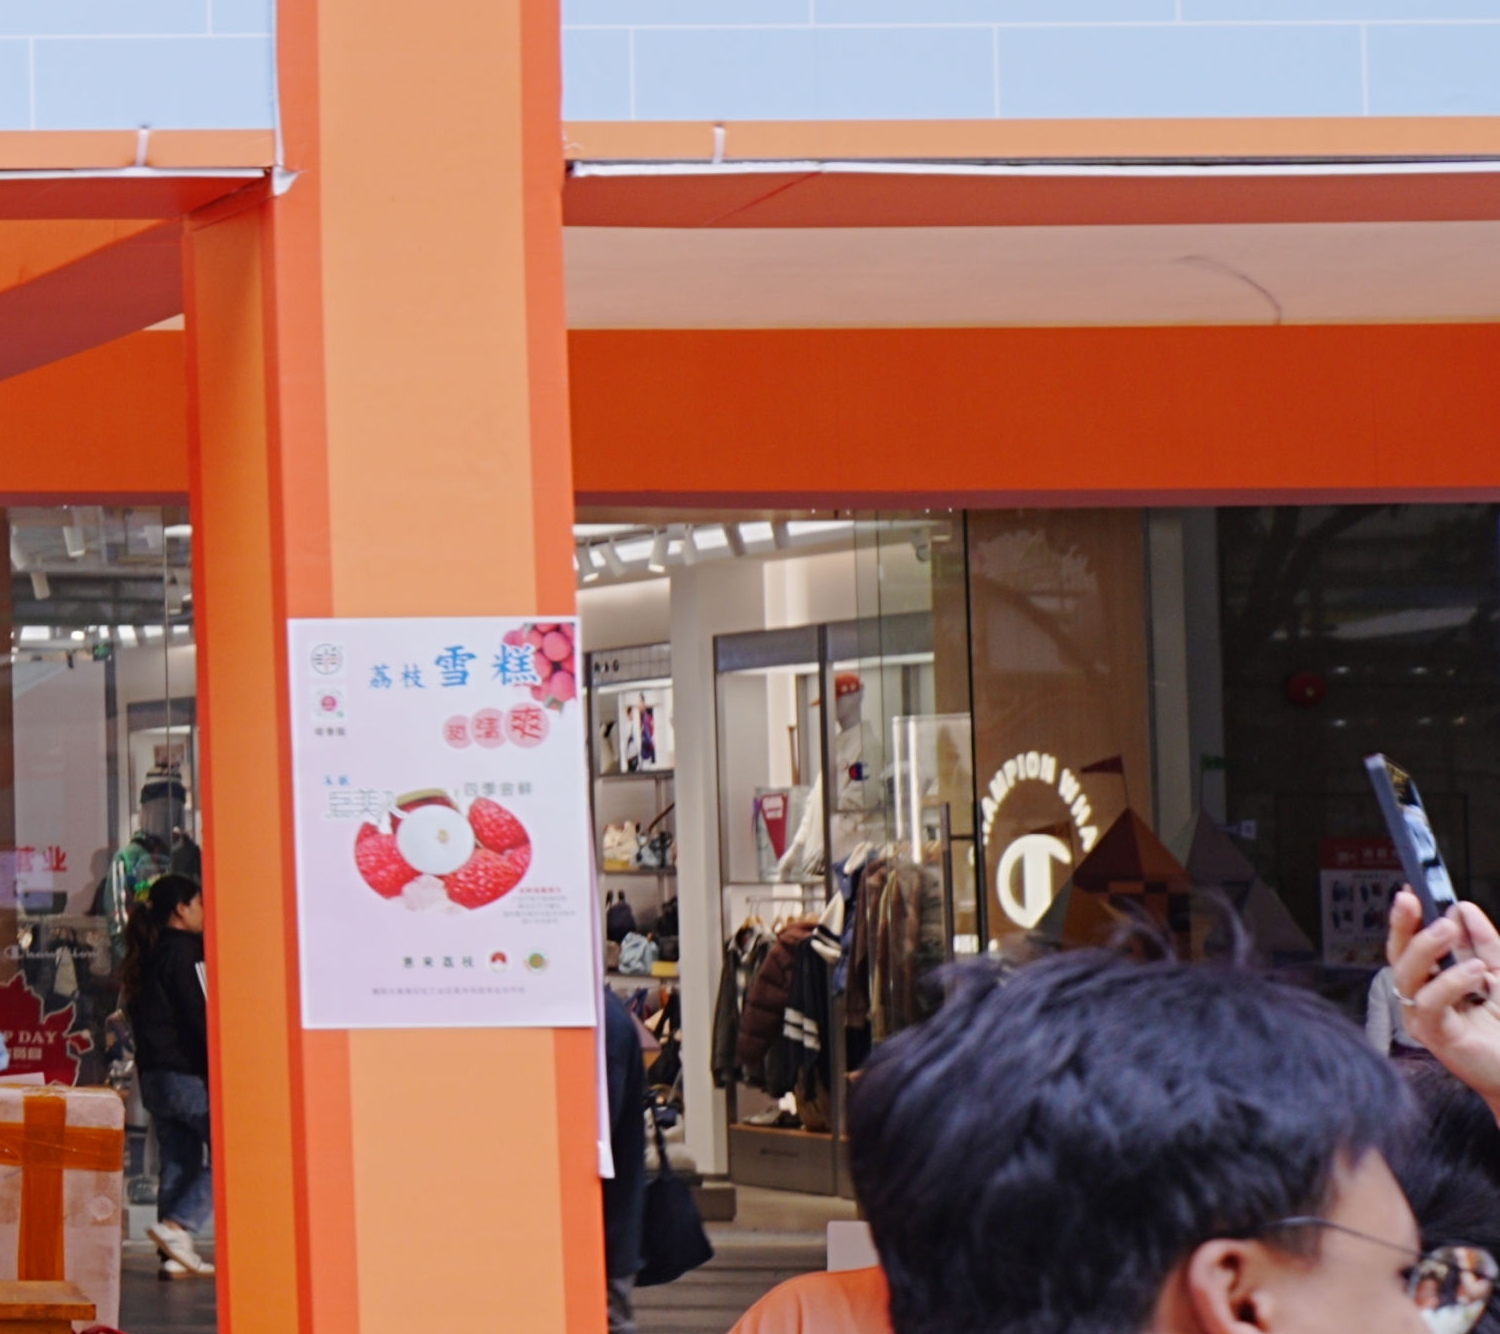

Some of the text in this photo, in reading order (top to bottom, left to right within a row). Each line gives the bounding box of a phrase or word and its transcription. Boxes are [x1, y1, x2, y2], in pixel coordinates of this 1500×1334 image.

[369, 645, 539, 689] 荔枝雪糕
[18, 1030, 58, 1044] DAY
